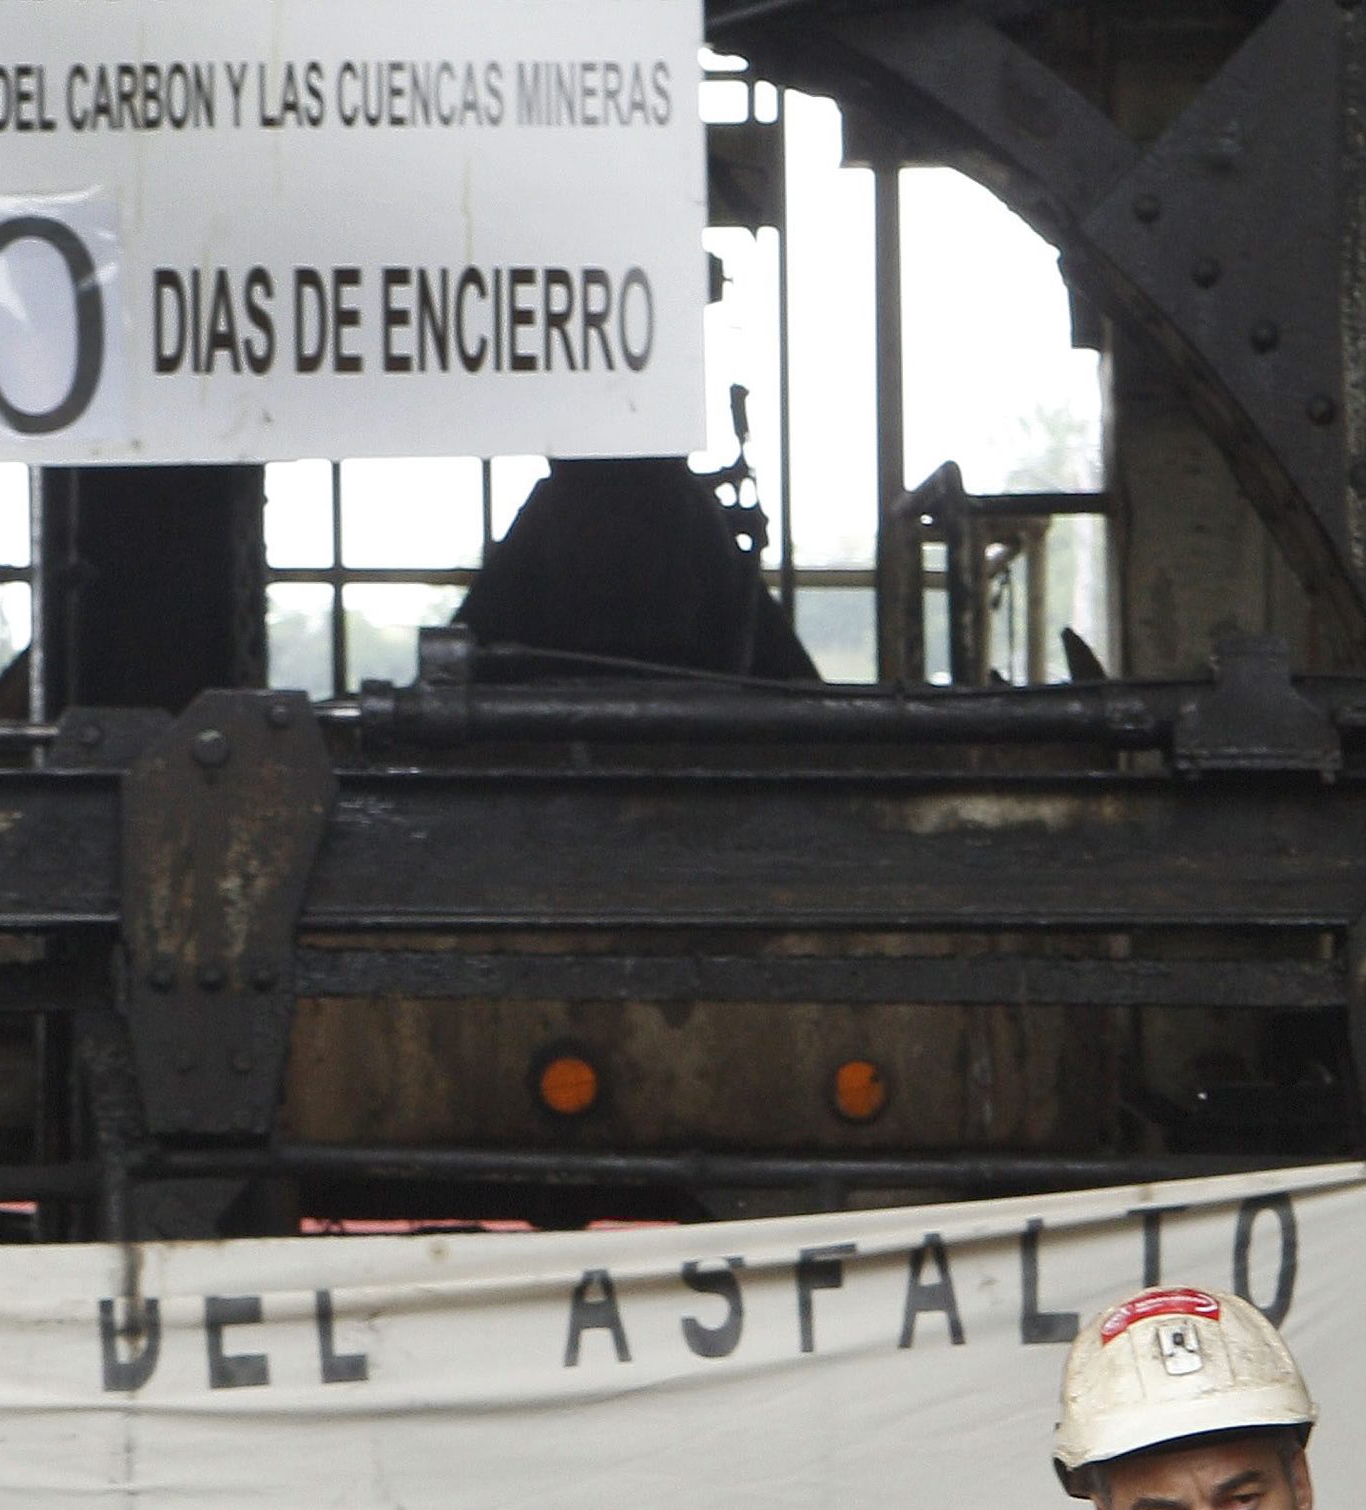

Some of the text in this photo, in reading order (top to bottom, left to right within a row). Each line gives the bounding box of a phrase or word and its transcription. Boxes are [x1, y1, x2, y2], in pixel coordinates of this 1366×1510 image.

[65, 61, 216, 133] CARBON
[223, 61, 249, 129] Y
[258, 61, 326, 130] LAS
[336, 60, 504, 129] CUENCAS
[514, 60, 674, 129] MINERAS
[152, 265, 277, 377] DIAS
[293, 266, 364, 375] DE
[380, 264, 655, 375] ENCIERRO
[98, 1287, 370, 1392] DEL
[563, 1192, 1299, 1367] ASFALTO
